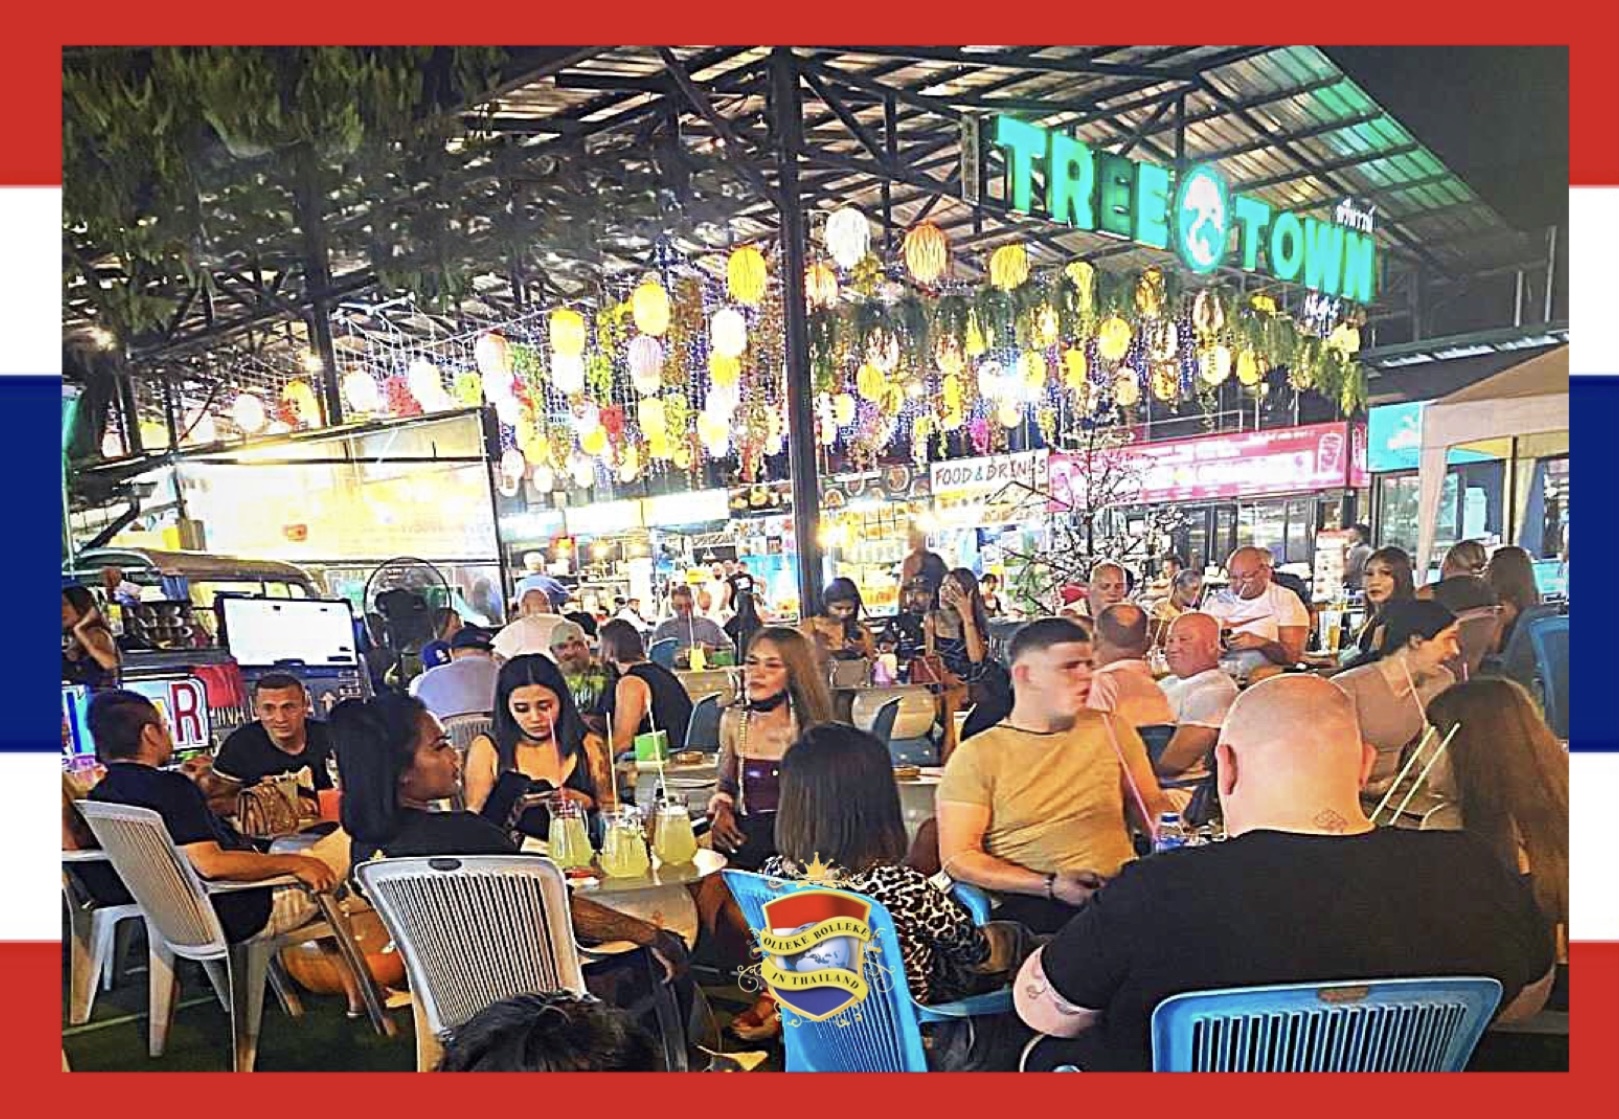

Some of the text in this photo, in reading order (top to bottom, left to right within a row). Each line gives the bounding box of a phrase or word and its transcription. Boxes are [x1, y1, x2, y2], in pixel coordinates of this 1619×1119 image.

[997, 114, 1376, 304] TREE TOWN
[935, 466, 973, 486] FOOD
[974, 465, 984, 482] &
